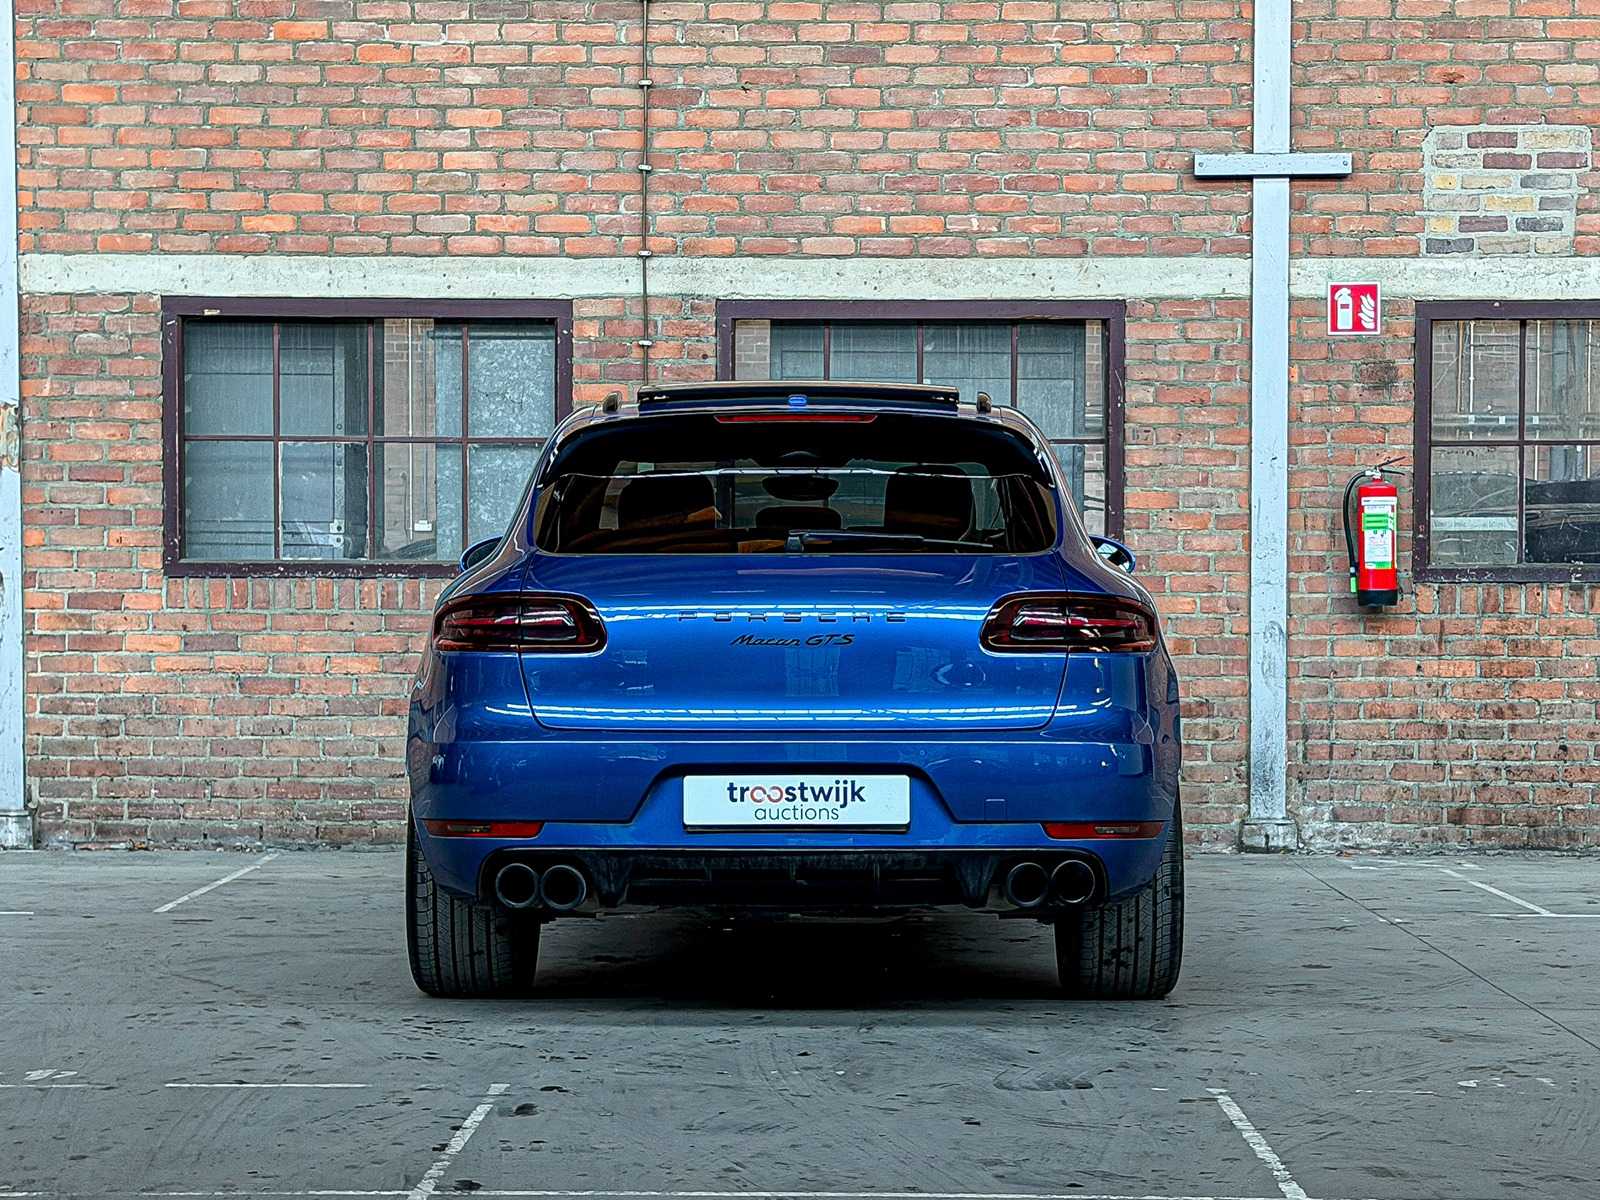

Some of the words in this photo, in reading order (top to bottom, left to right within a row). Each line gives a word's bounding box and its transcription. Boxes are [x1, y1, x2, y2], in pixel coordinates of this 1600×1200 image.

[679, 611, 906, 623] PORSCHE
[730, 634, 801, 646] Macan
[805, 633, 855, 646] GTS
[727, 780, 866, 808] troostwijk
[754, 804, 840, 821] auctions
